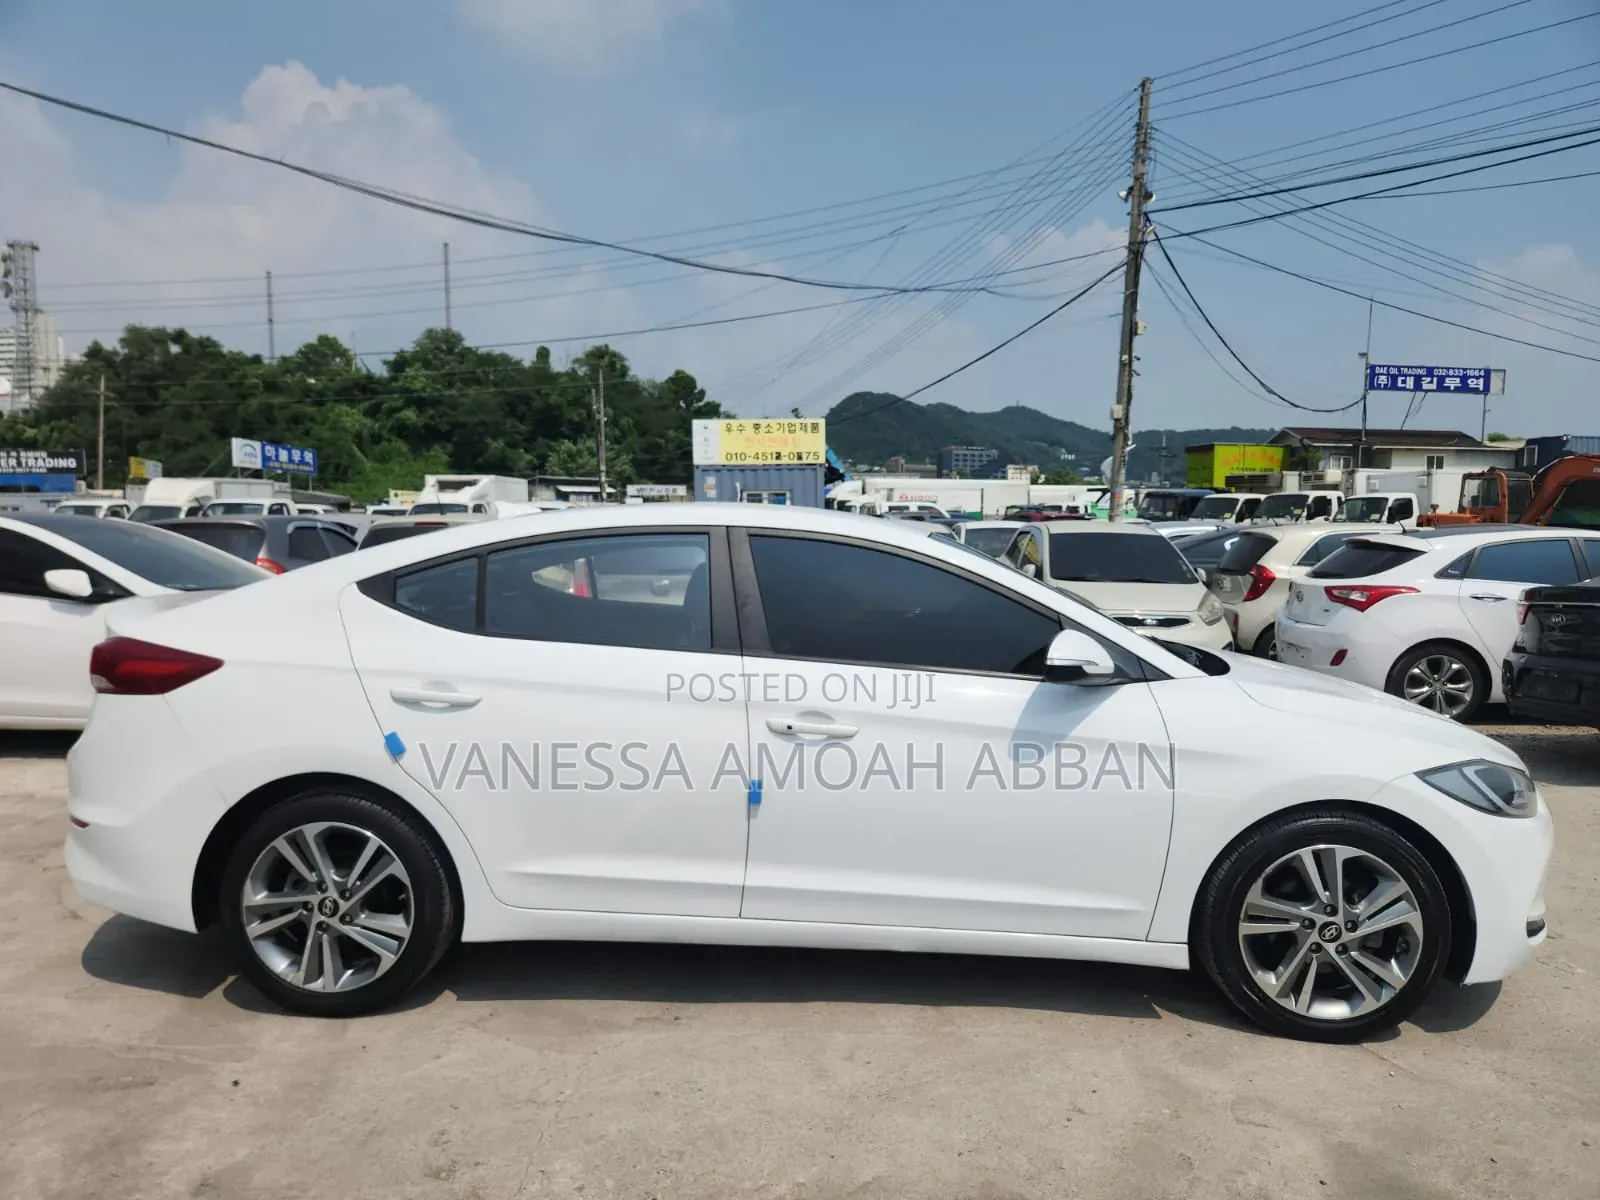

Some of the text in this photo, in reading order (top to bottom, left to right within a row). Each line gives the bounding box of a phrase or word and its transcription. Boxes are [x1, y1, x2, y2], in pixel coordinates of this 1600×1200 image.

[1375, 366, 1388, 374] DAE
[1400, 367, 1427, 376] TRADING
[1374, 375, 1484, 391] (주) 대길무역
[724, 422, 820, 435] 우수 중소기업제품
[20, 457, 77, 469] TRADING
